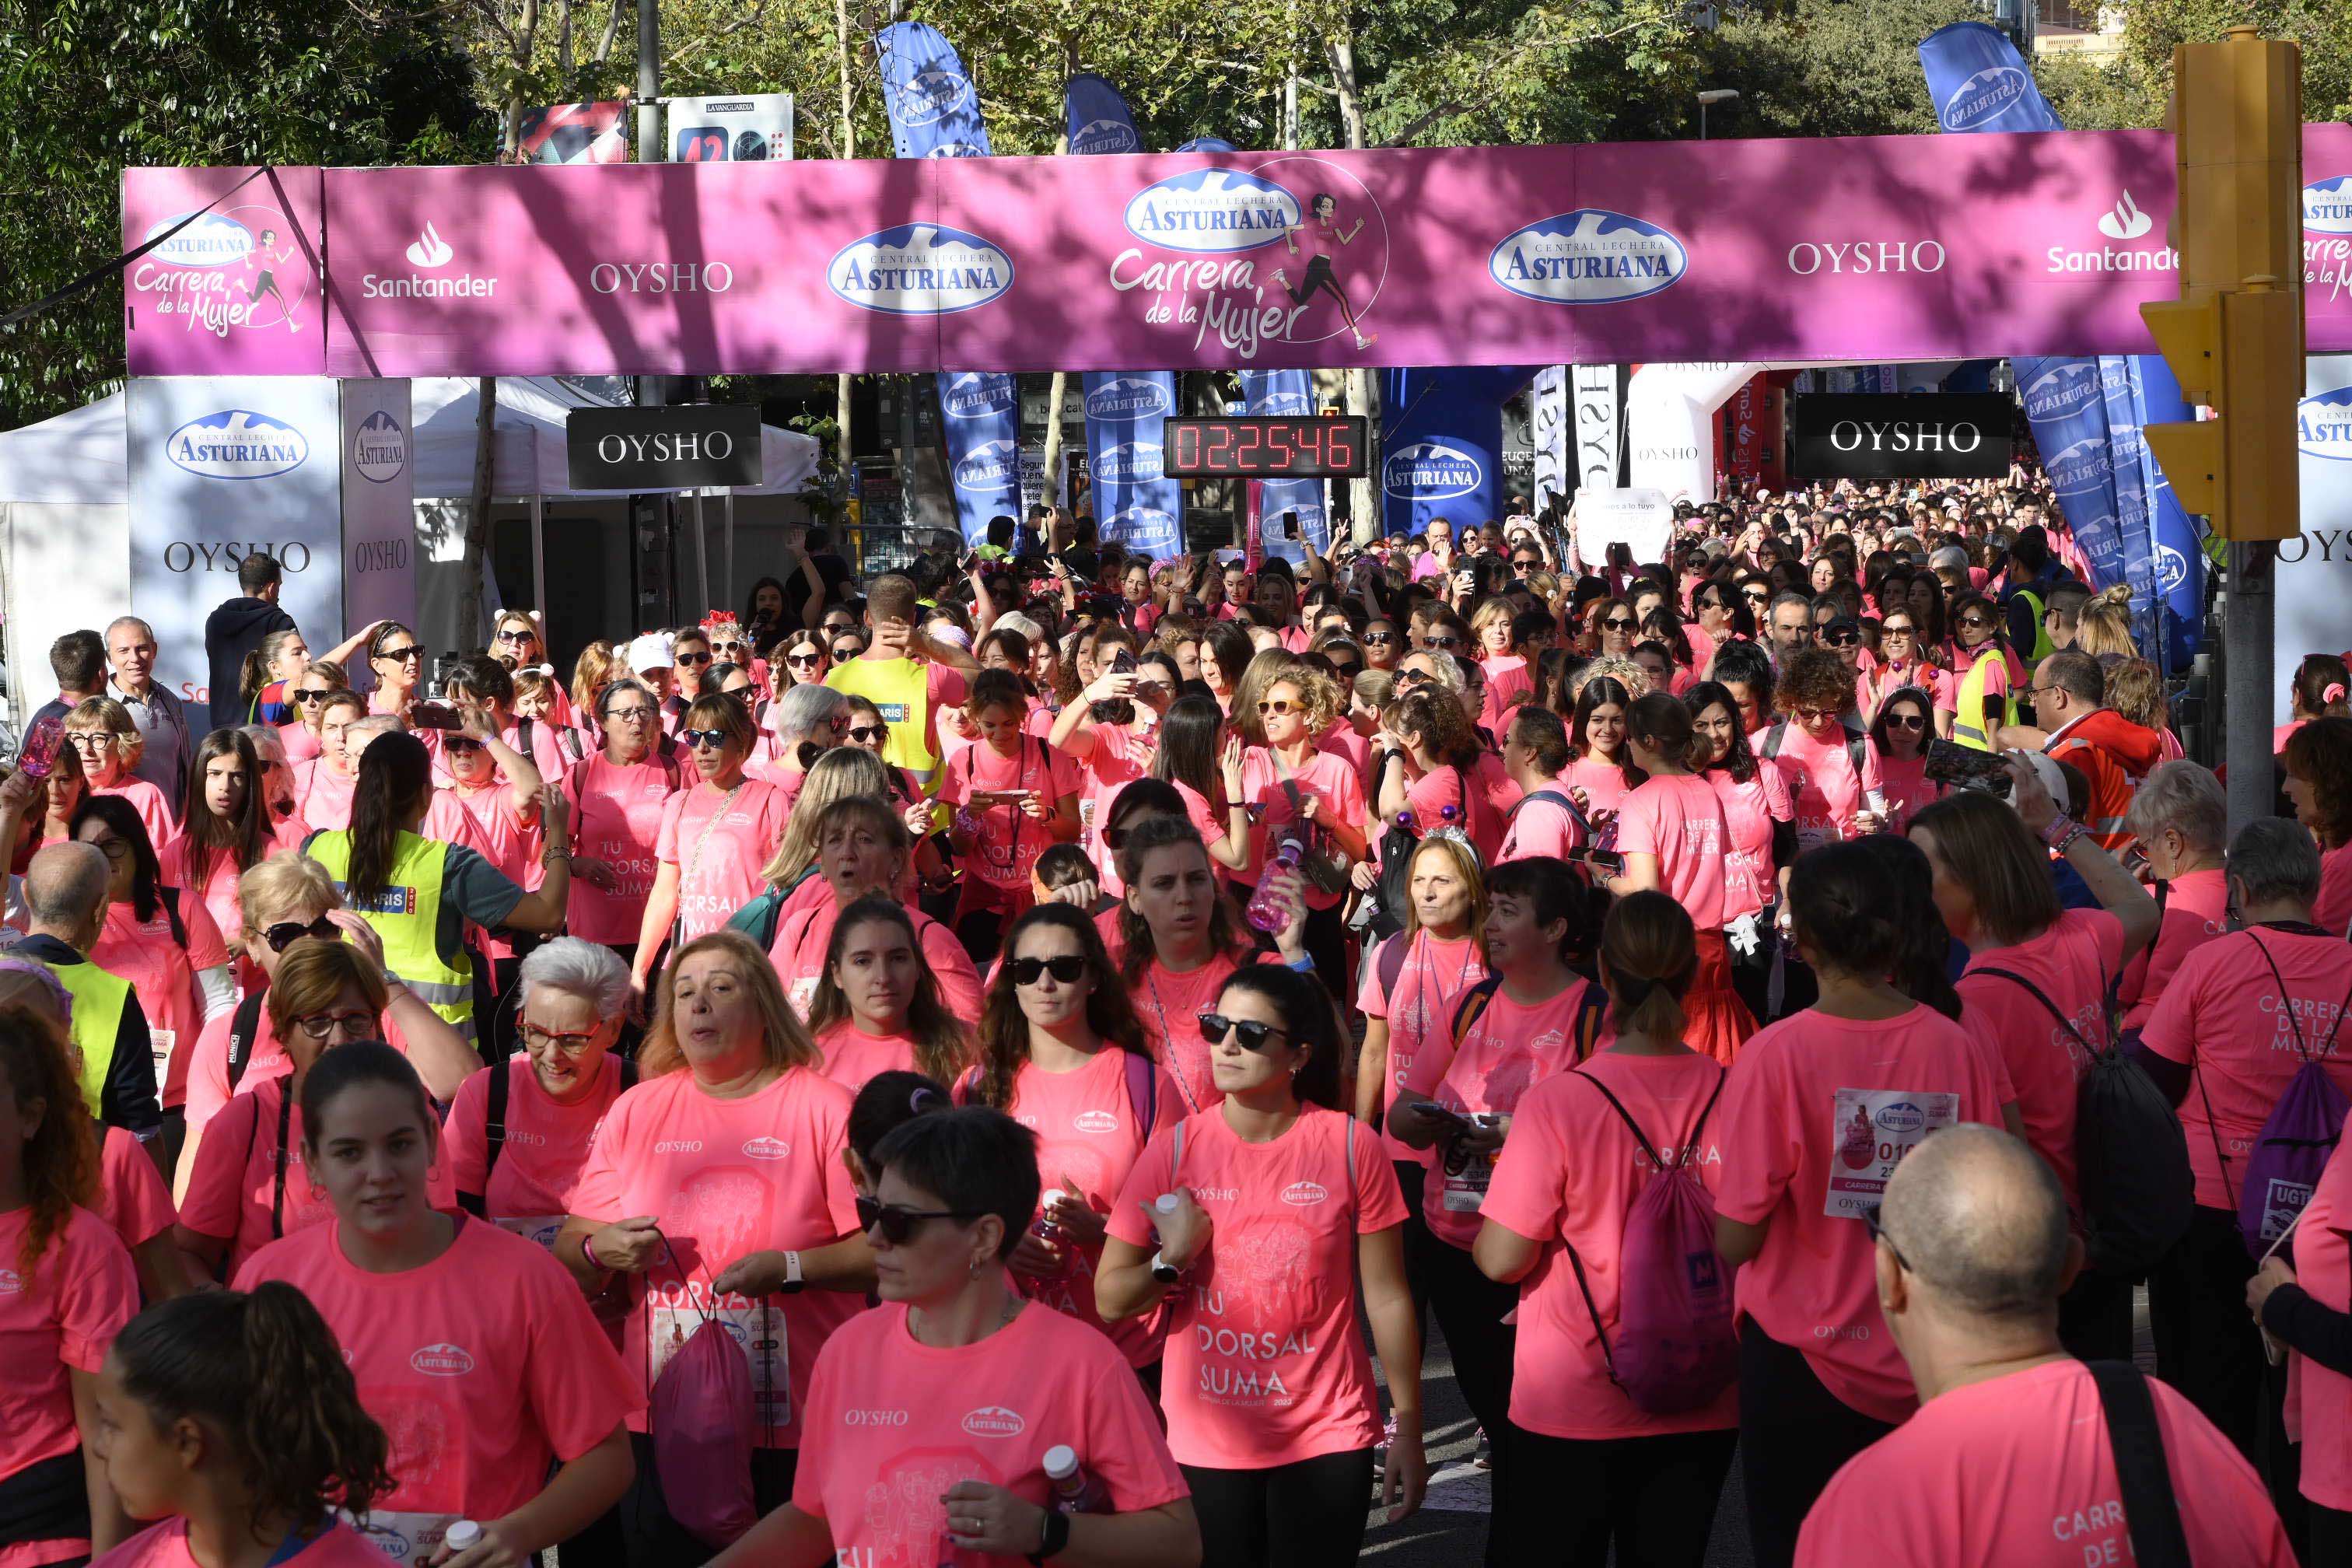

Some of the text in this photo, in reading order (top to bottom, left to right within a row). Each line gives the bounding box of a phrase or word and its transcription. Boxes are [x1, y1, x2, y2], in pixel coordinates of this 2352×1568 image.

[1165, 195, 1283, 206] CENTRAL LECHERA
[1139, 200, 1286, 231] ASTURIANA
[1535, 240, 1665, 253] CENTRAL LECHERA
[1788, 240, 1945, 275] OYSHO
[871, 254, 993, 264] CENTRAL LECHERA
[1110, 248, 1255, 292] Carrera
[1504, 246, 1672, 280] ASTURIANA
[134, 262, 226, 292] Carrera
[590, 262, 733, 294] OYSHO
[842, 257, 999, 291] ASTURIANA
[2319, 262, 2334, 283] la
[362, 272, 497, 298] Santander
[157, 289, 261, 338] de la Mujer
[1146, 285, 1310, 359] de la Mujer
[597, 431, 733, 463] OYSHO
[1177, 425, 1350, 468] 02:25:46
[1830, 421, 1981, 453] OYSHO
[177, 436, 298, 462] ASTURIANA
[357, 437, 403, 465] ASTURIANA
[1639, 446, 1698, 460] OYSHO
[1387, 467, 1474, 488] ASTURIANA
[355, 538, 407, 573] OYSHO
[600, 840, 622, 855] TU
[1724, 851, 1761, 866] RSAL
[2277, 1014, 2336, 1036] DE LA
[229, 1034, 240, 1063] MUNICH
[1467, 1028, 1504, 1048] OYSHO
[2271, 1033, 2340, 1057] MUJER
[246, 1054, 279, 1070] YSHO
[1079, 1118, 1116, 1128] ASTURIANA
[1880, 1111, 1920, 1125] ASTURIANA
[654, 1141, 702, 1153] OYSHO
[746, 1145, 786, 1156] ASTURIANA
[1285, 1190, 1325, 1202] ASTURIANA
[1845, 1181, 1881, 1191] CARRERA
[1447, 1195, 1469, 1206] OYSHO
[1196, 1286, 1224, 1316] TU
[1197, 1324, 1316, 1360] DORSAL
[416, 1354, 468, 1370] ASTURIANA
[1200, 1363, 1288, 1395] SUMA
[845, 1409, 909, 1426] OYSHO
[966, 1415, 1019, 1431] ASTURIANA
